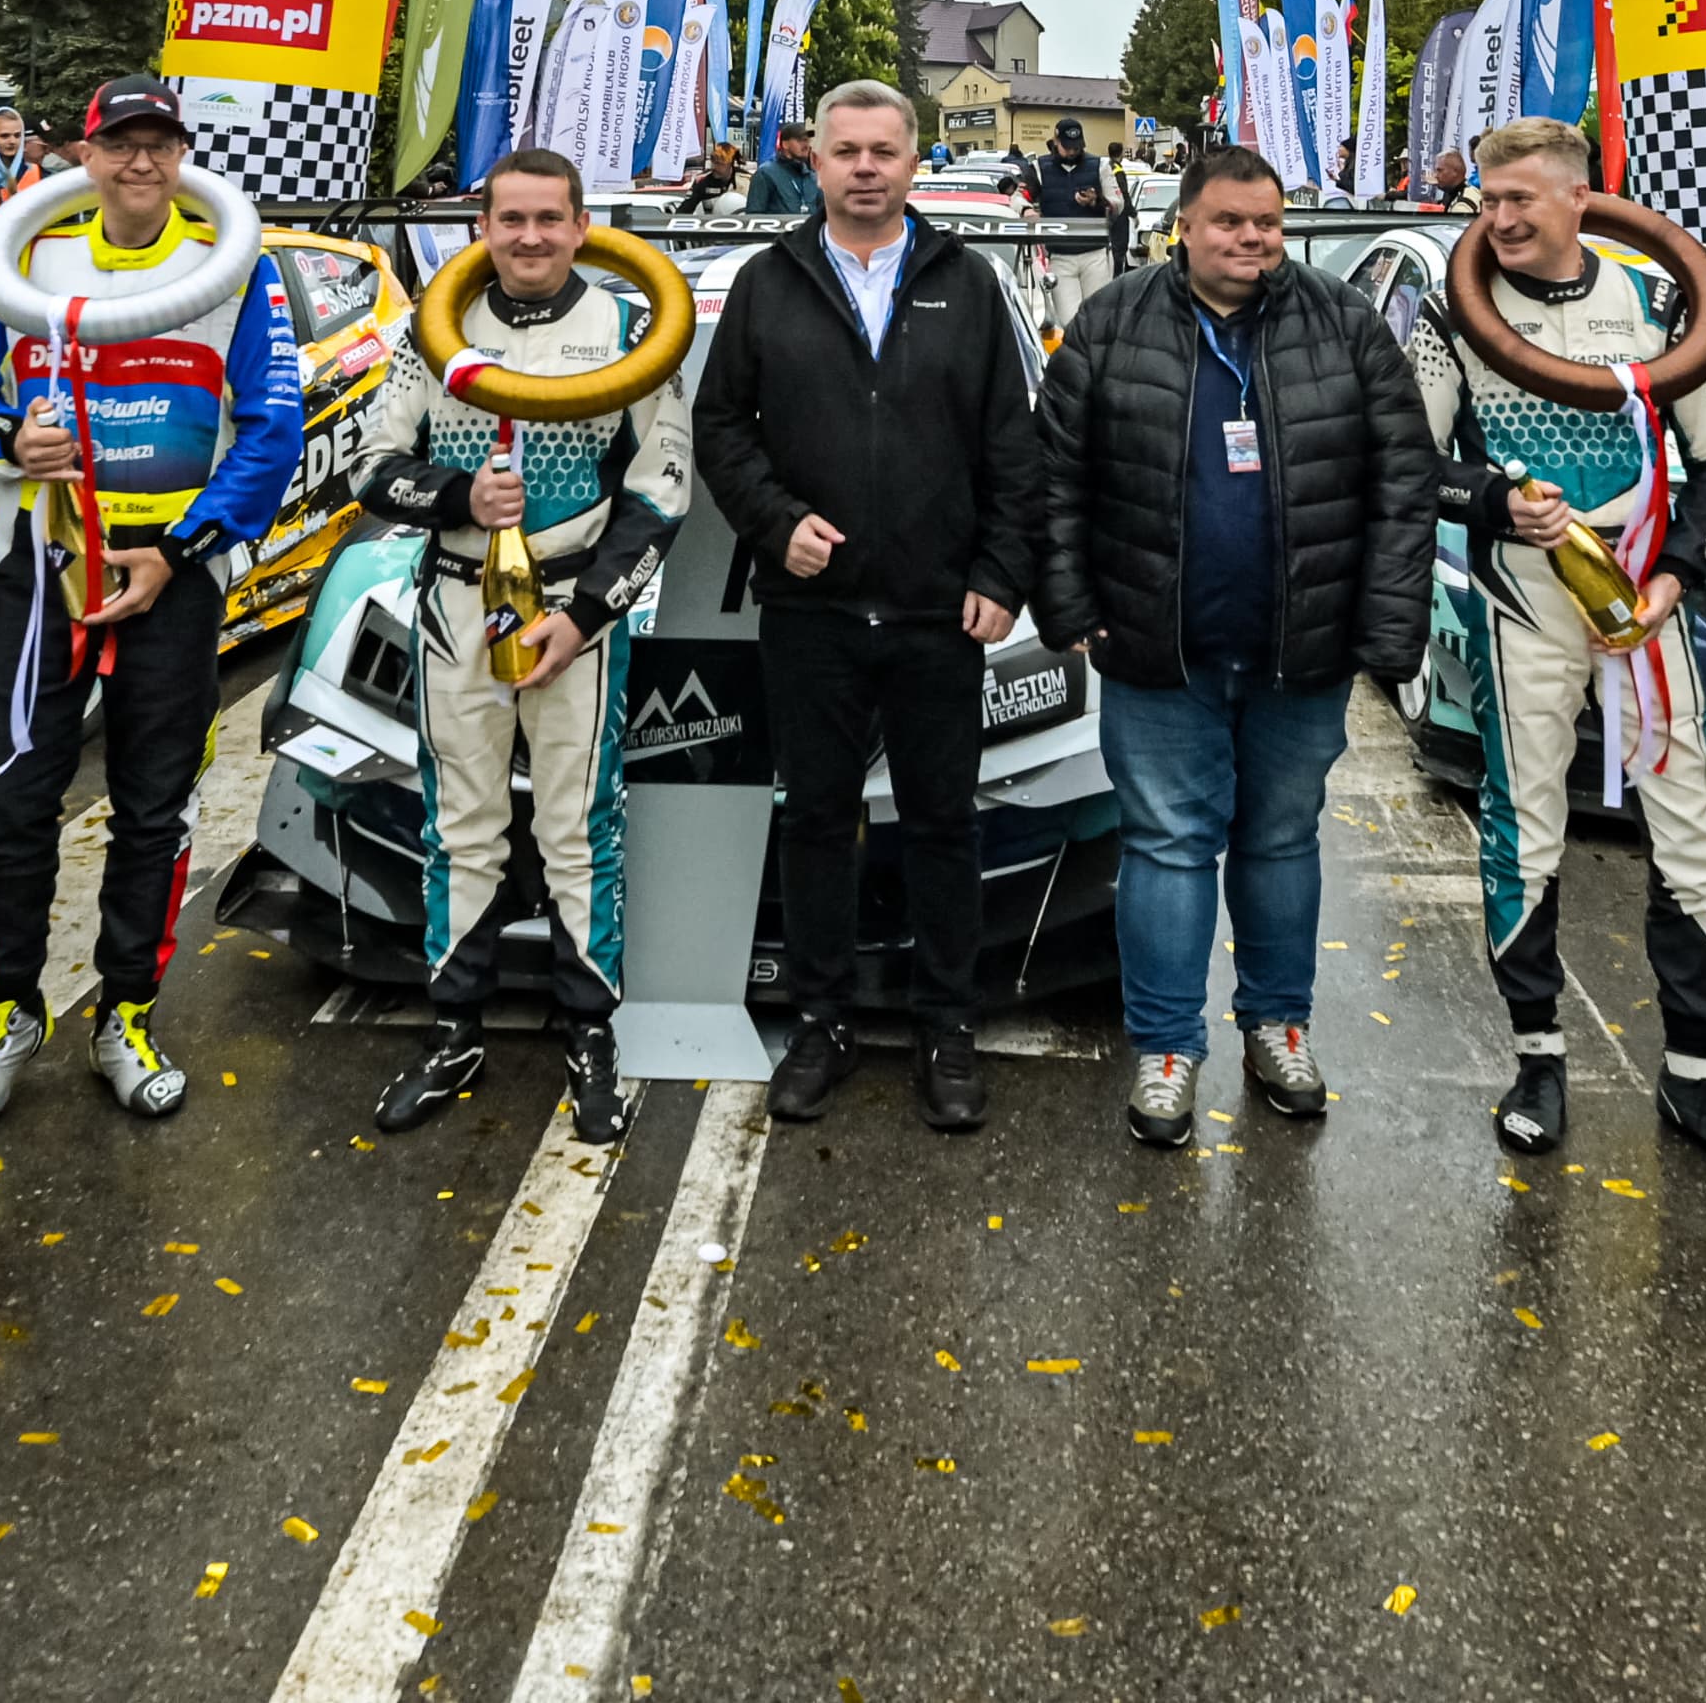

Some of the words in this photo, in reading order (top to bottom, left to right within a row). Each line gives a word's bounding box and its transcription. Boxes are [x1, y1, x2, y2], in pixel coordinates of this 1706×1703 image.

[190, 0, 323, 42] pzm.pl
[620, 35, 632, 90] KROSNO
[324, 284, 371, 315] S.Stec
[104, 444, 155, 462] BAREZI
[985, 666, 1068, 711] CUSTOM
[990, 688, 1068, 726] TECHNOLOGY
